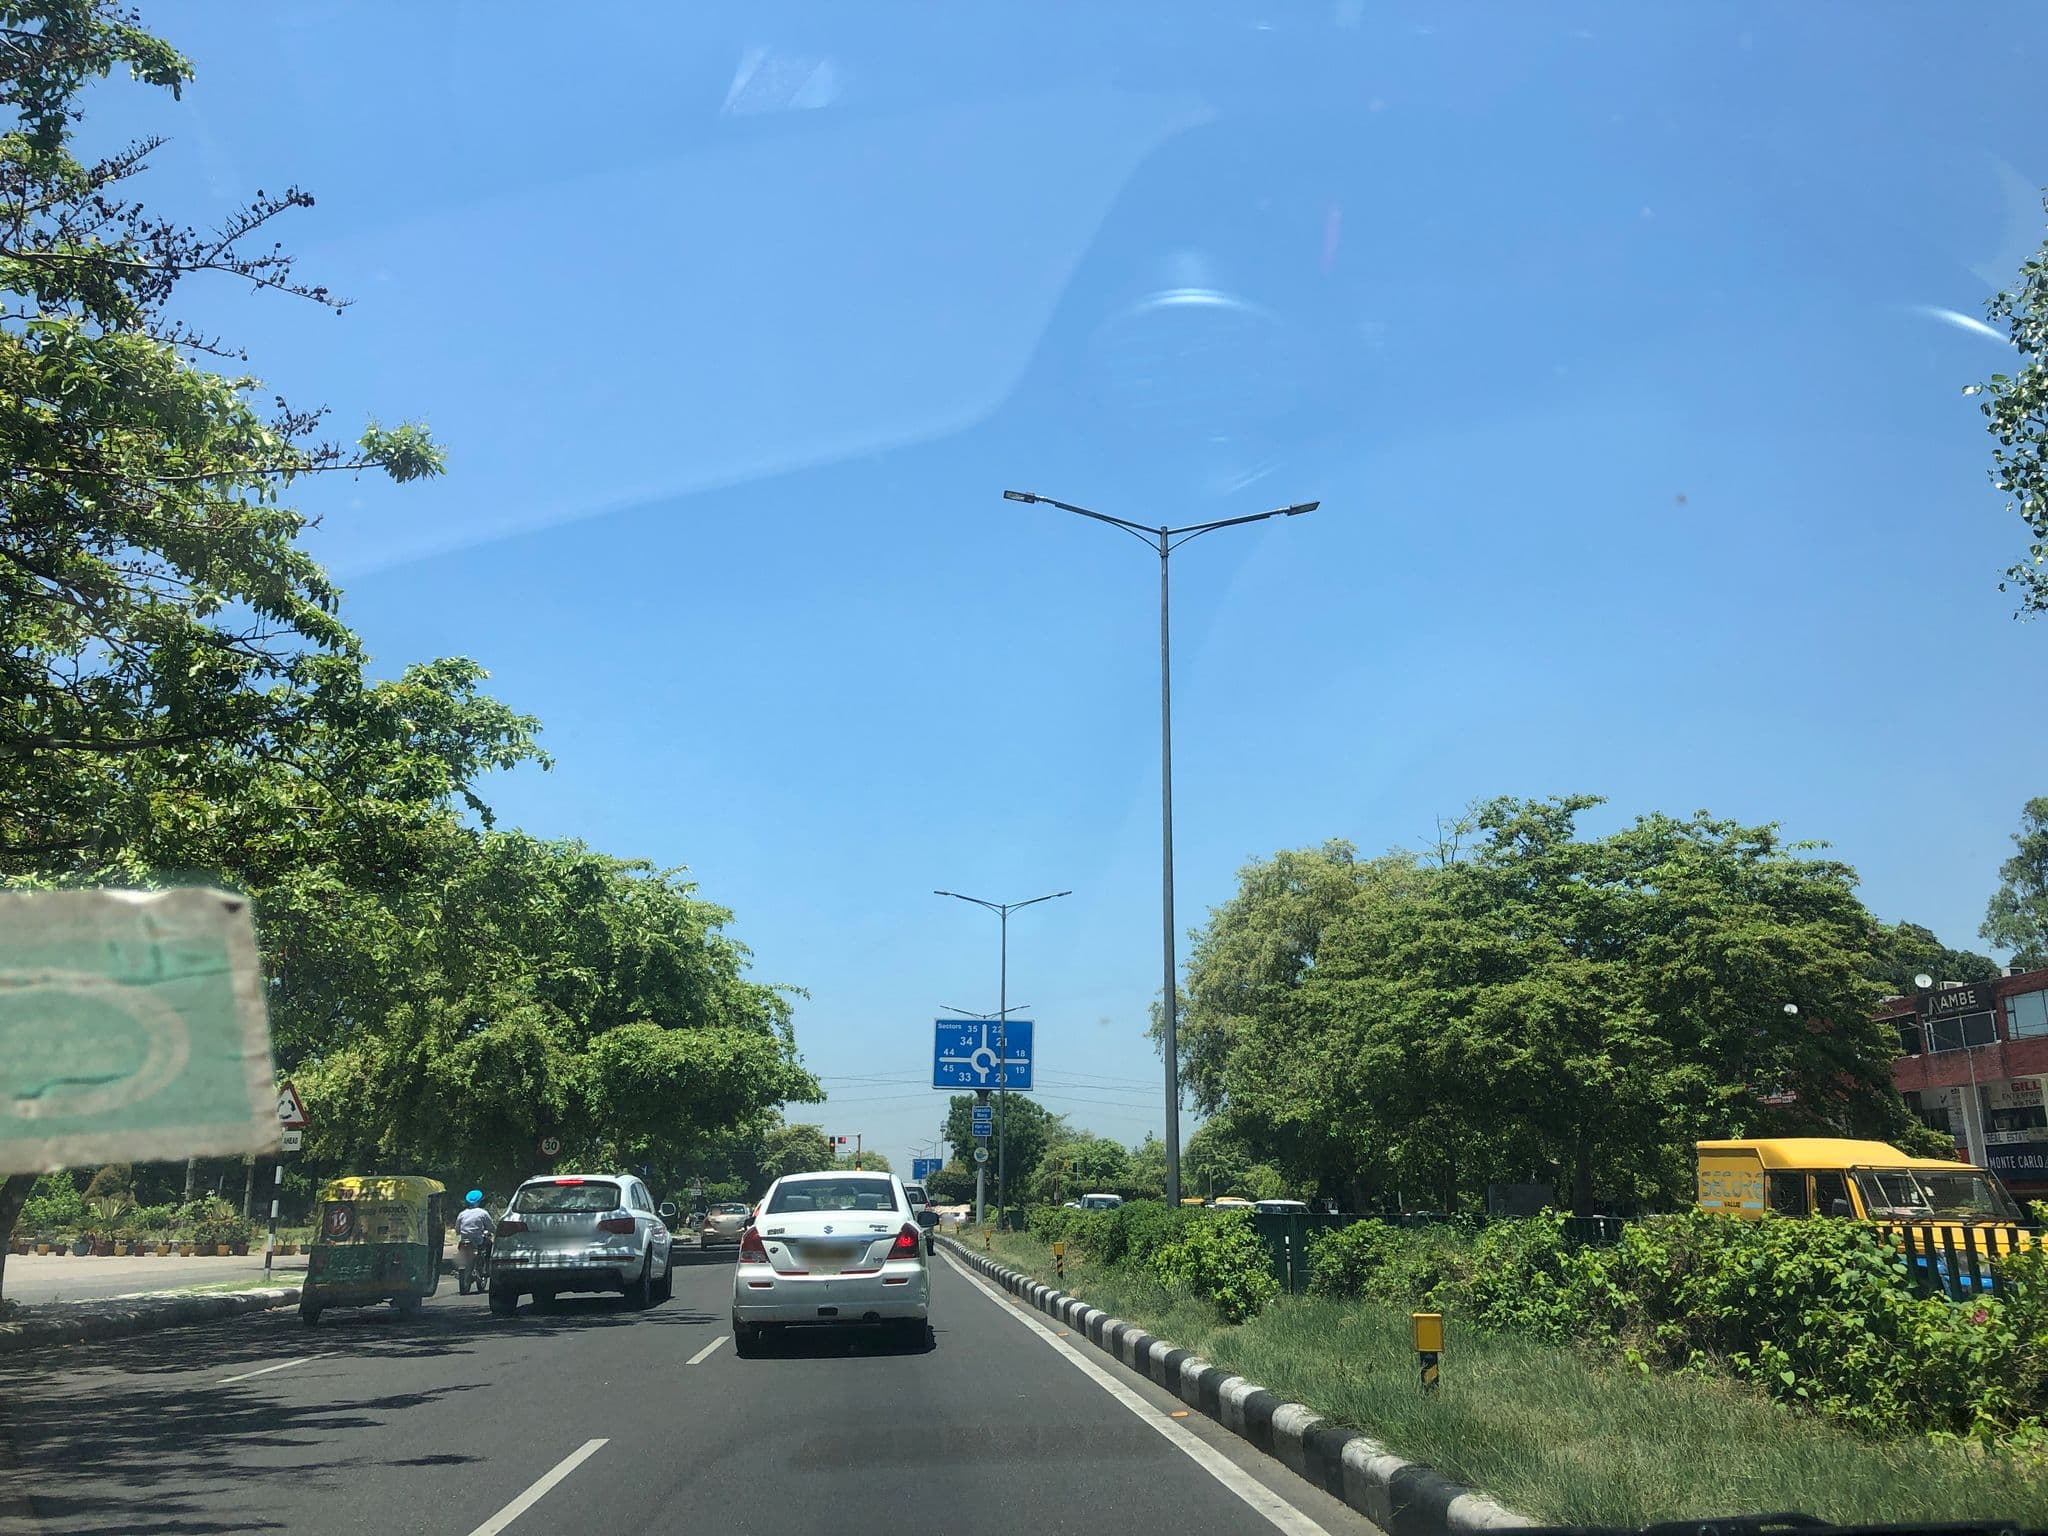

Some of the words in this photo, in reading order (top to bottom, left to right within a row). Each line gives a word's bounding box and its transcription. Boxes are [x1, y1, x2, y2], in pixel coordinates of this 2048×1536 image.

[1940, 990, 1976, 1009] AMBE
[967, 1025, 978, 1033] 35
[959, 1036, 973, 1046] 34
[995, 1037, 1008, 1047] 21
[943, 1048, 955, 1056] 44
[1016, 1049, 1026, 1057] 18
[942, 1064, 954, 1073] 45
[1015, 1066, 1025, 1074] 19
[958, 1072, 972, 1082] 33
[2010, 1080, 2041, 1092] GILL
[1986, 1133, 2005, 1143] REAL
[544, 1141, 558, 1151] 30
[1989, 1155, 2015, 1169] MONTE
[2017, 1154, 2044, 1168] CARLO
[1701, 1170, 1764, 1200] SECURE
